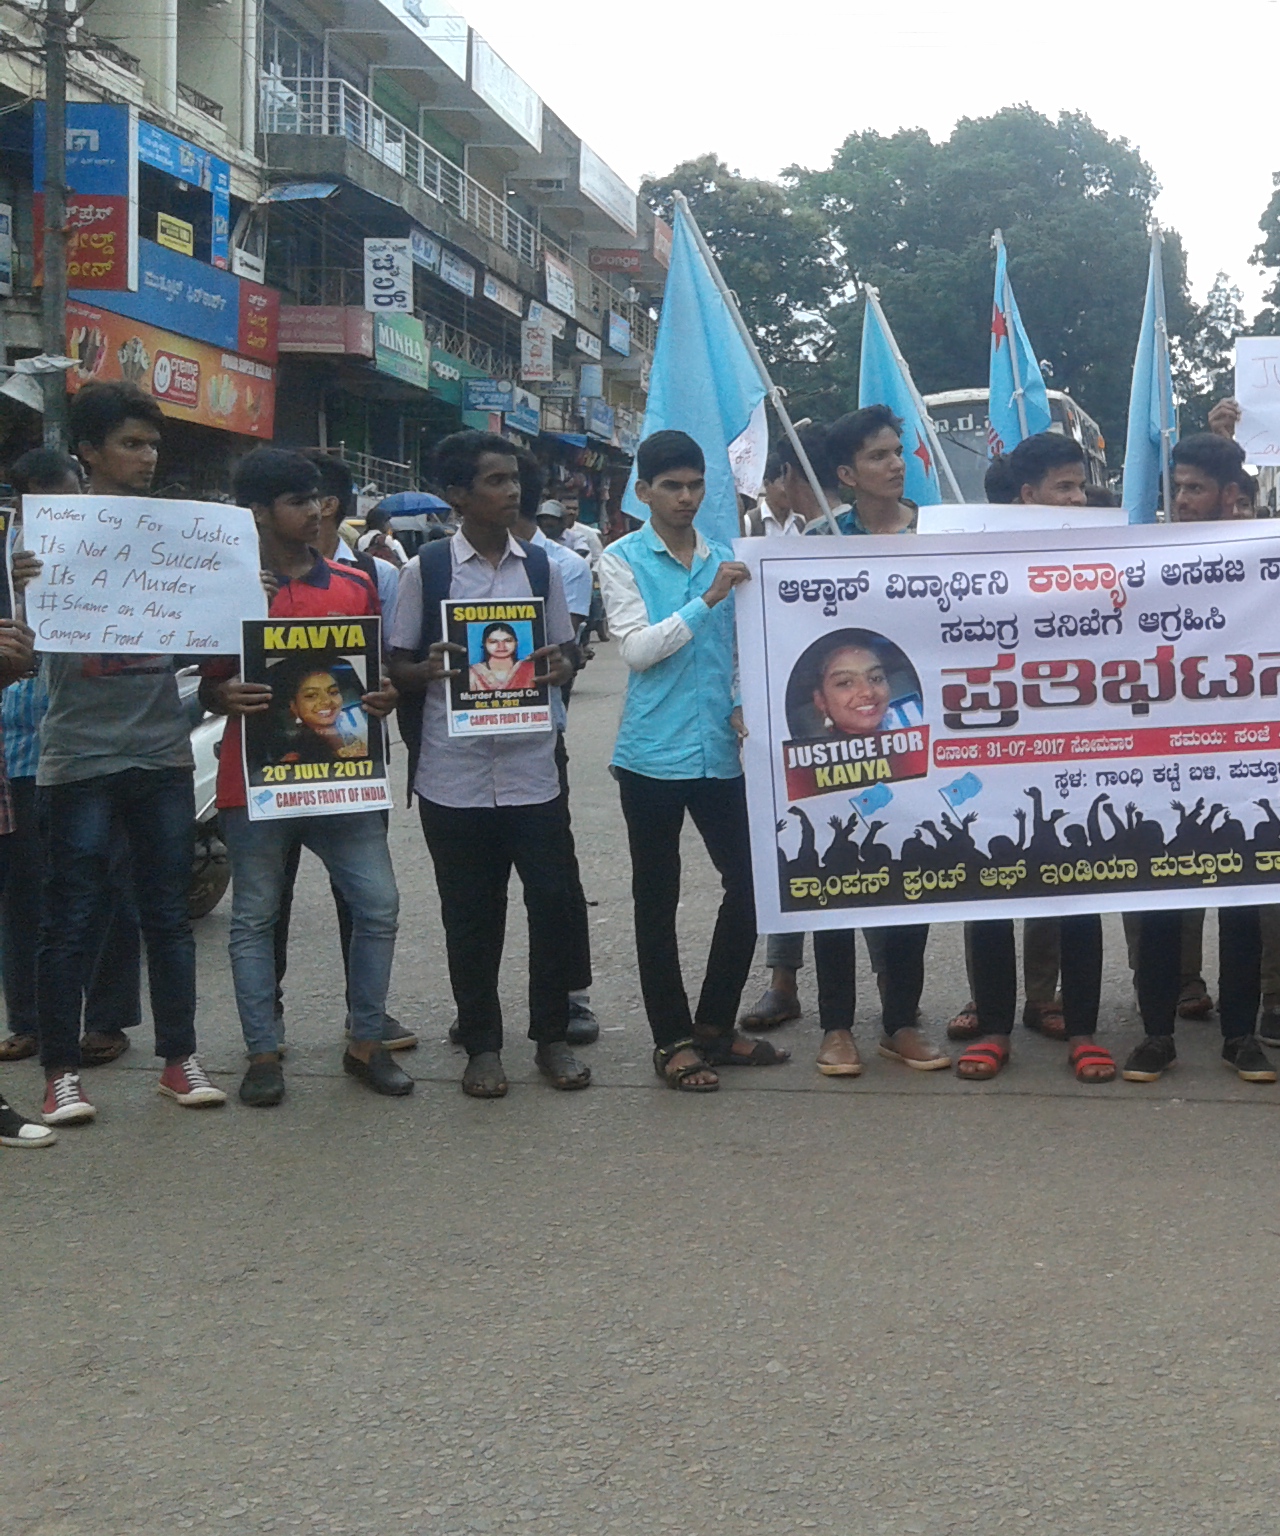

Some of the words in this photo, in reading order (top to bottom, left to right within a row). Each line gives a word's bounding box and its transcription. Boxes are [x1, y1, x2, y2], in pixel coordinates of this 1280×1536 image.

[590, 254, 638, 268] Orange
[378, 322, 424, 364] MINHA
[97, 508, 123, 530] Cry
[137, 514, 164, 533] For
[181, 517, 240, 547] Justice
[39, 534, 66, 556] Its
[76, 539, 107, 558] Not
[114, 544, 132, 562] A
[151, 541, 222, 572] Suicide
[48, 564, 76, 586] Its
[92, 569, 108, 588] A
[122, 568, 197, 595] Murder
[778, 570, 870, 618] ಆಳ್ವಾಸ್
[885, 569, 1009, 612] ವಿದ್ಯಾರ್ಥಿನಿ
[1027, 559, 1146, 609] ಕಾವ್ಯಾಳ
[1161, 553, 1246, 586] ಅಸಹಜ
[118, 603, 135, 617] on
[143, 601, 182, 620] Alvas
[453, 605, 537, 621] SOUJANYA
[38, 618, 92, 645] Campus
[102, 625, 144, 646] Front
[186, 630, 220, 648] India
[263, 625, 367, 650] KAVYA
[940, 613, 1019, 650] ಸಮಗ್ರ
[1034, 606, 1123, 639] ತನಿಖೆಗೆ
[1138, 604, 1226, 642] ಆಗ್ರಹಿಸಿ
[460, 691, 493, 701] Murder
[495, 689, 525, 701] Raped
[526, 688, 539, 698] On
[470, 713, 499, 726] CAMPUS
[500, 712, 520, 724] FRONT
[522, 712, 531, 723] OF
[531, 711, 549, 723] INDIA
[788, 738, 878, 769] JUSTICE
[881, 731, 924, 755] FOR
[936, 745, 982, 761] ದಿನಾಂಕ:
[985, 738, 1065, 759] 31-07-2017
[1071, 734, 1134, 754] ಸೋಮವಾರ
[1169, 731, 1227, 748] ಸಮಯ:
[1235, 726, 1271, 745] ಸಂಜೆ
[293, 762, 330, 780] JULY
[333, 760, 374, 778] 2017
[815, 758, 893, 788] KAVYA
[1054, 769, 1088, 799] ಸ್ಥಳ:
[1095, 766, 1144, 788] ಗಾಂಧಿ
[1152, 763, 1181, 792] ಕಟ್ಟೆ
[275, 791, 317, 808] CAMPUS
[318, 788, 346, 805] FRONT
[348, 787, 360, 803] OF
[361, 786, 387, 801] INDIA
[790, 866, 890, 907] ಕ್ಯಾಂಪಸ್
[903, 863, 967, 901] ಫ್ರಂಟ್
[979, 859, 1028, 891] ಆಫ್
[1040, 854, 1138, 885] ಇಂಡಿಯಾ
[1151, 847, 1244, 884] ಪುತ್ತೂರು
